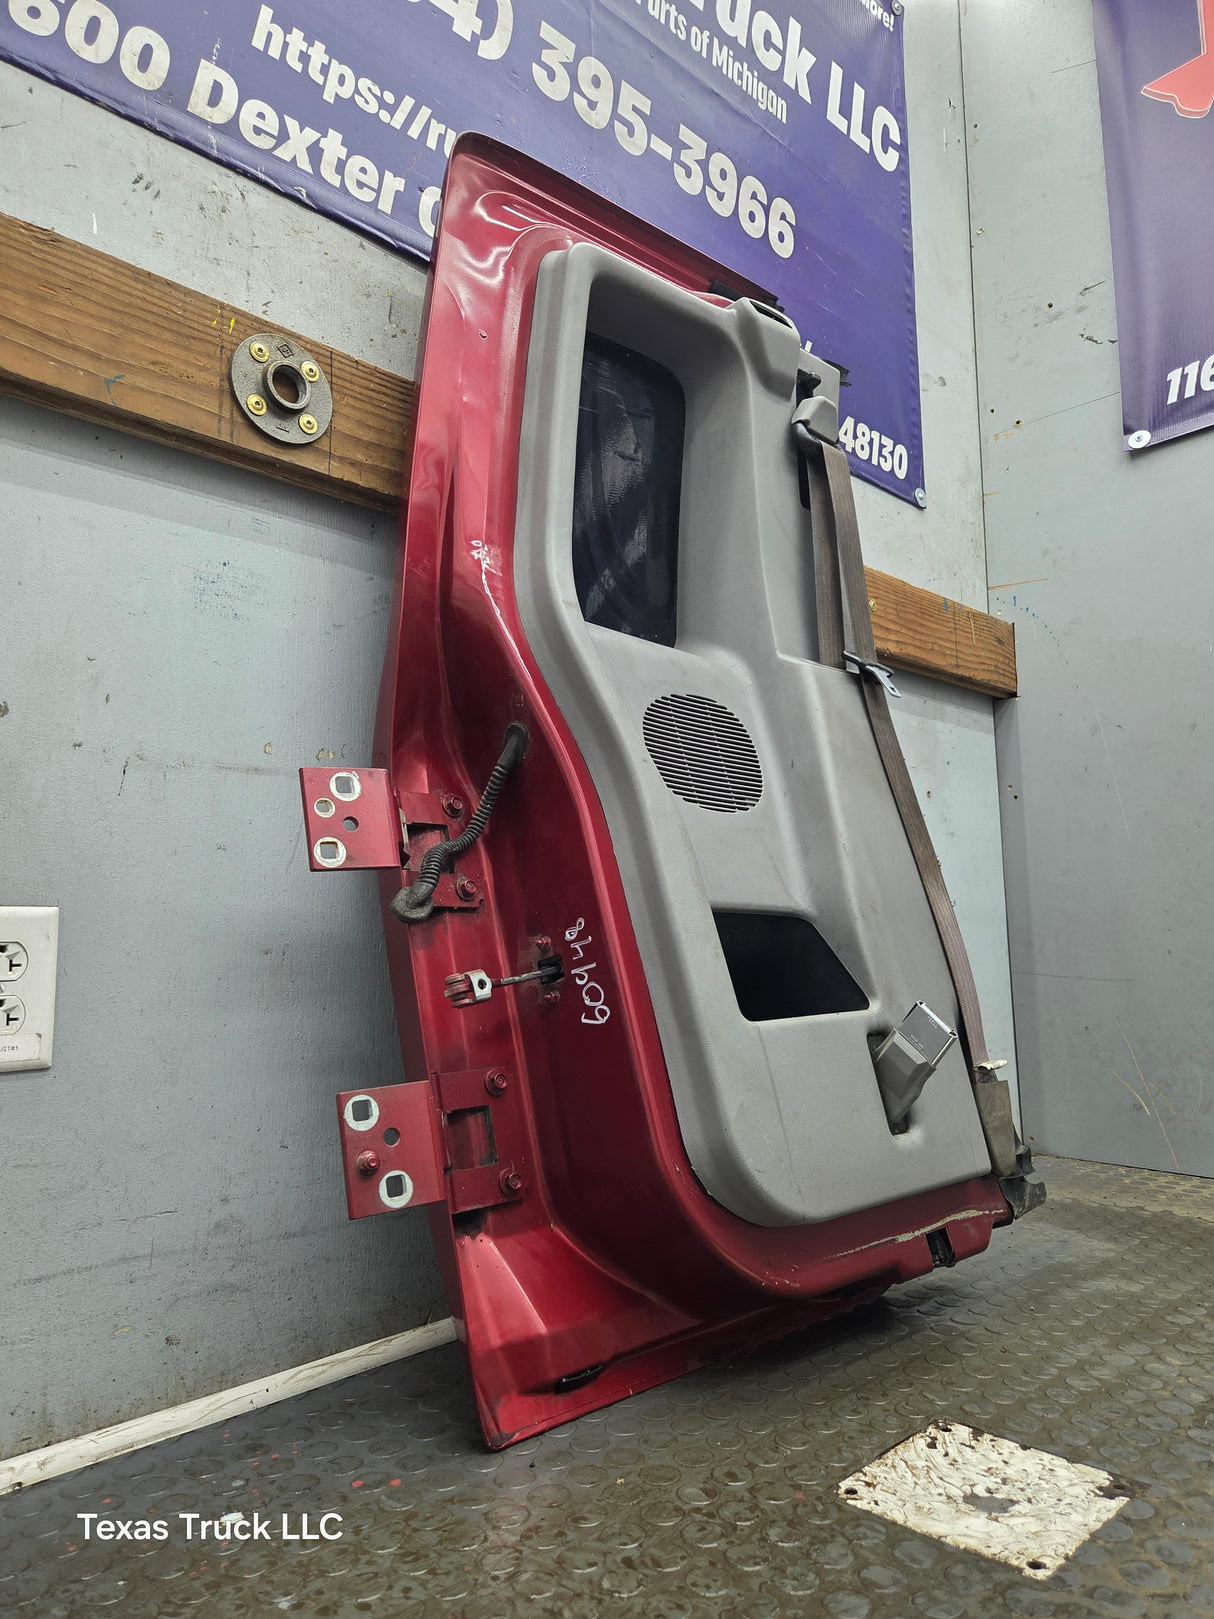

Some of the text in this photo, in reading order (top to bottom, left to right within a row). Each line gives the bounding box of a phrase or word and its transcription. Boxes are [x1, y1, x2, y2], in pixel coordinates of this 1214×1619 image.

[187, 58, 406, 215] Dexter
[532, 20, 796, 260] 395-3966
[636, 0, 787, 124] arts of Michigan
[689, 0, 902, 172] uck LLC
[838, 416, 908, 480] 48130
